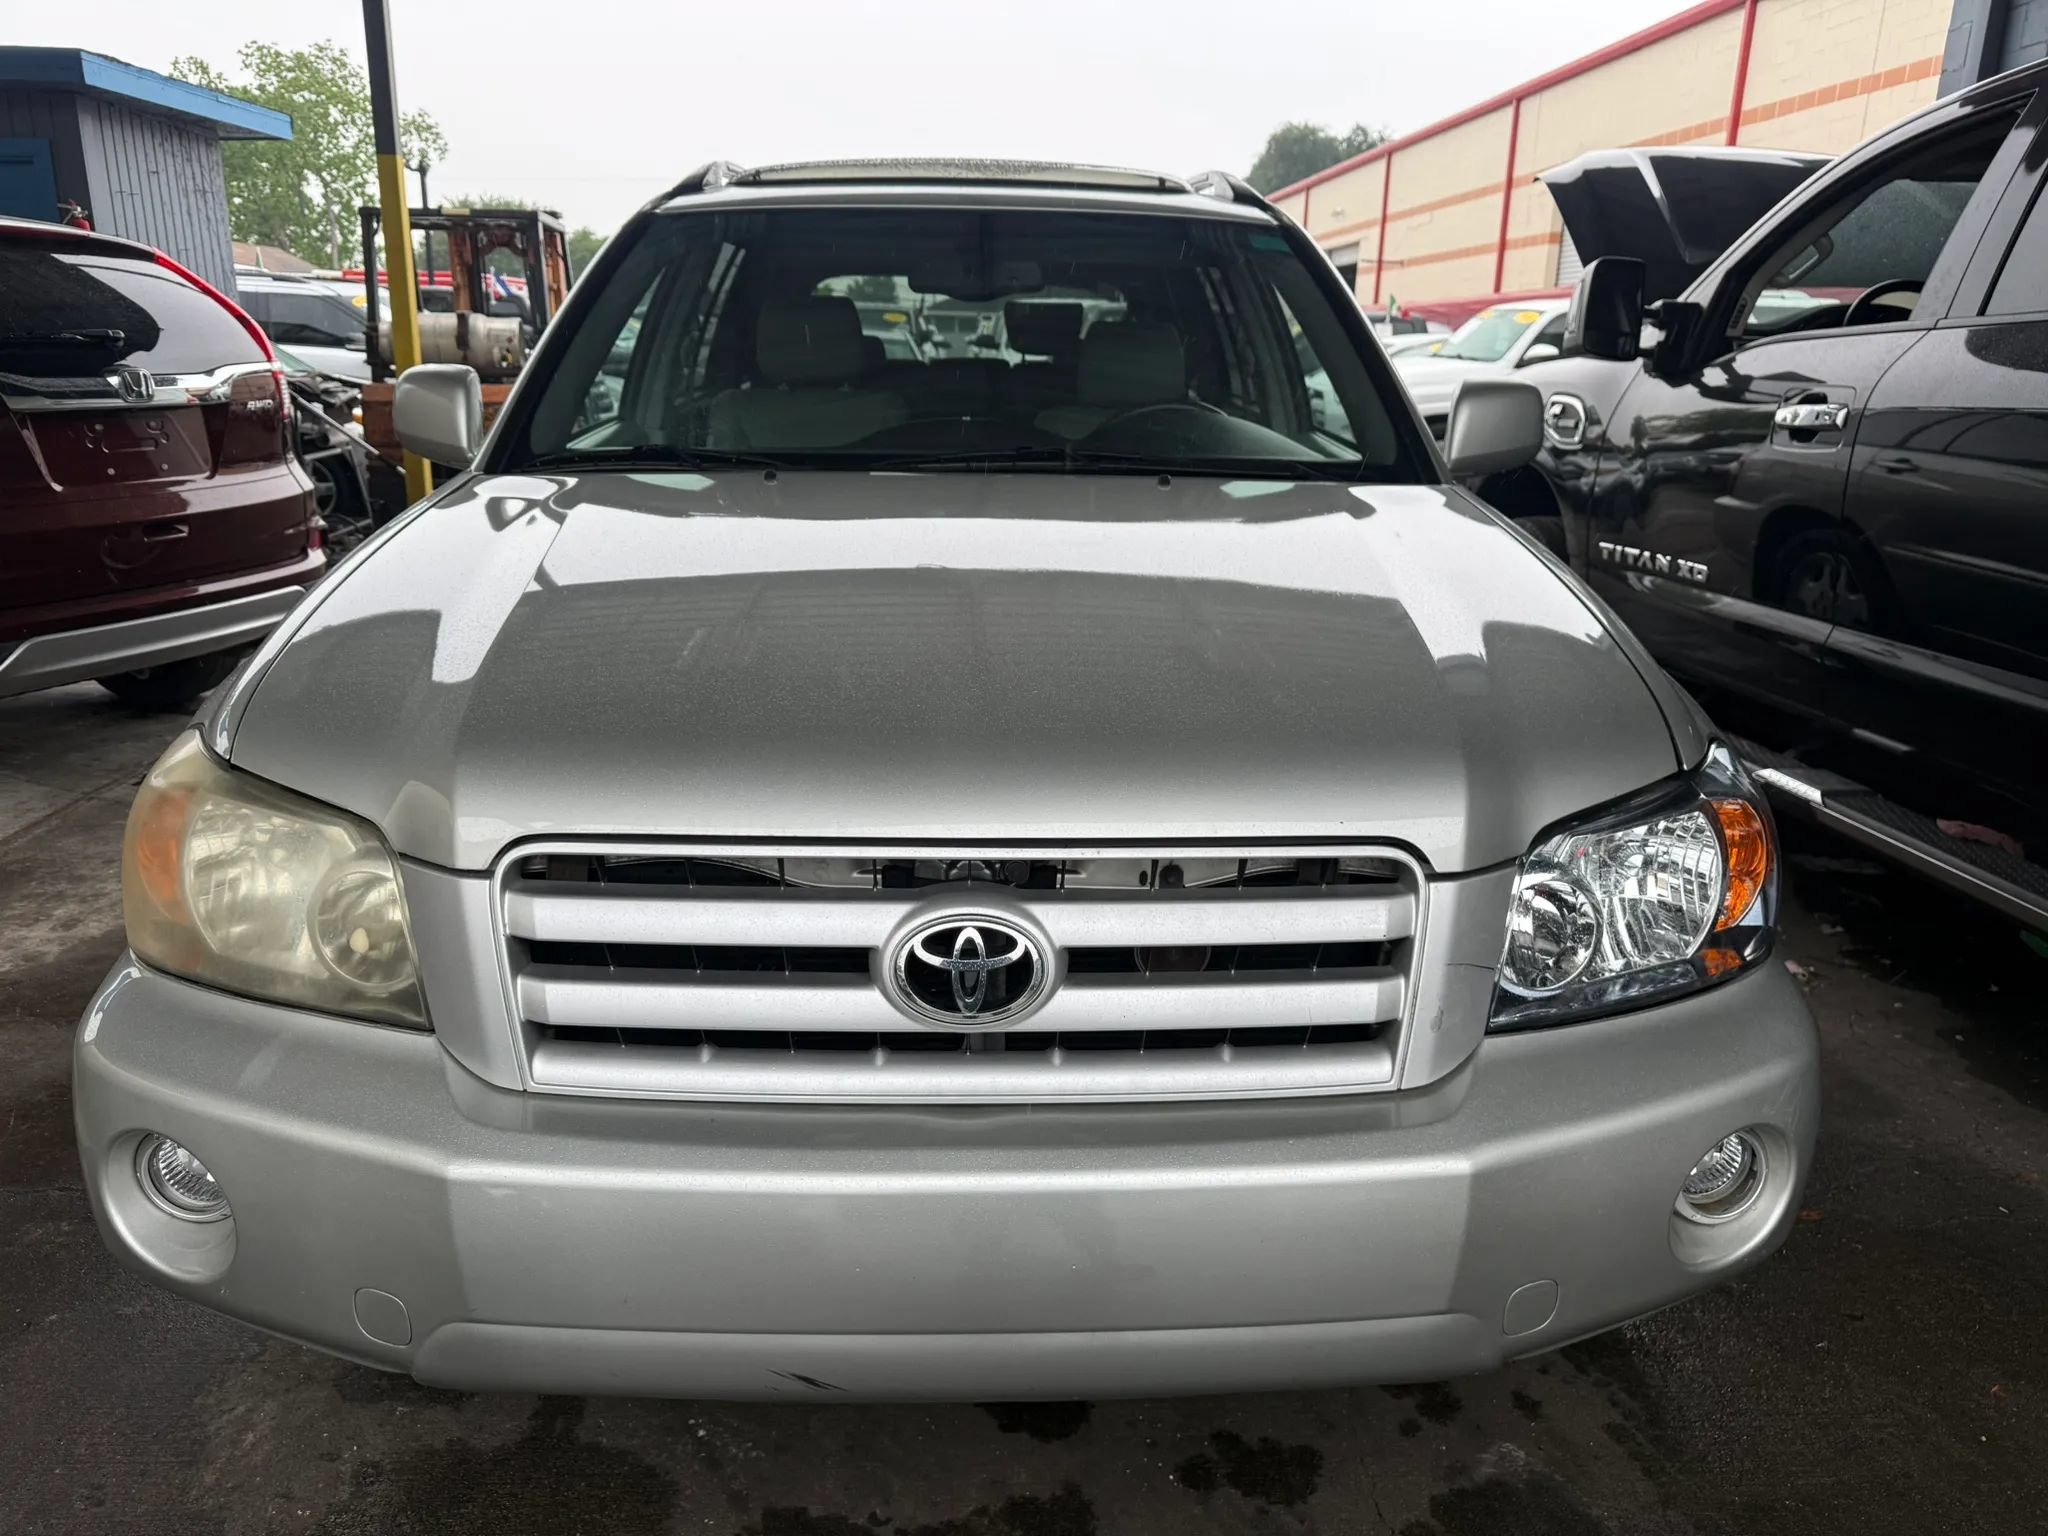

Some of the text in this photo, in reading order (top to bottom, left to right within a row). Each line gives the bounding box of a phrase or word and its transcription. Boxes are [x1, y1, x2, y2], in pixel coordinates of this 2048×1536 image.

[247, 399, 273, 410] AWD
[1599, 541, 1708, 582] TITAN XD
